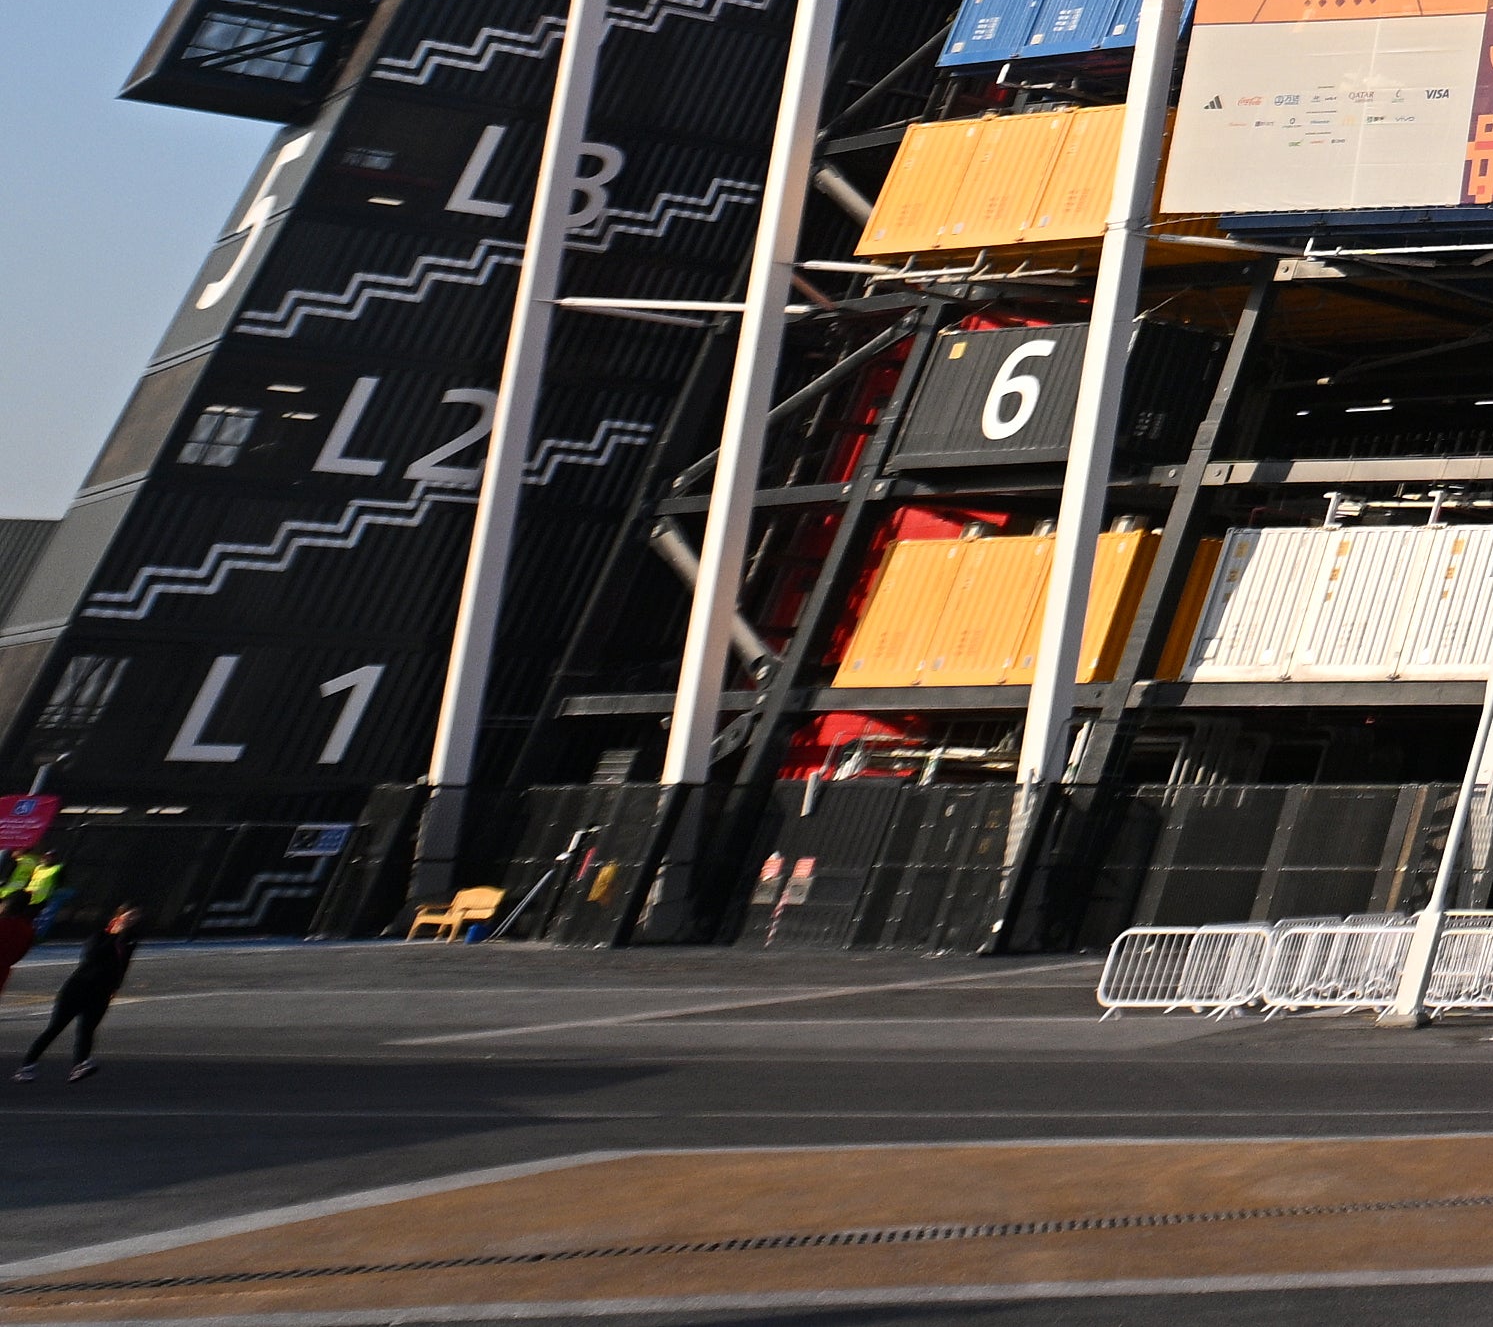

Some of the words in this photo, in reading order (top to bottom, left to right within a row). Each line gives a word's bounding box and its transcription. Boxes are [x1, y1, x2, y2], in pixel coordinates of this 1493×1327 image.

[1424, 88, 1450, 100] VISA
[311, 376, 500, 488] L2
[981, 339, 1057, 441] 6
[164, 654, 388, 765] L1
